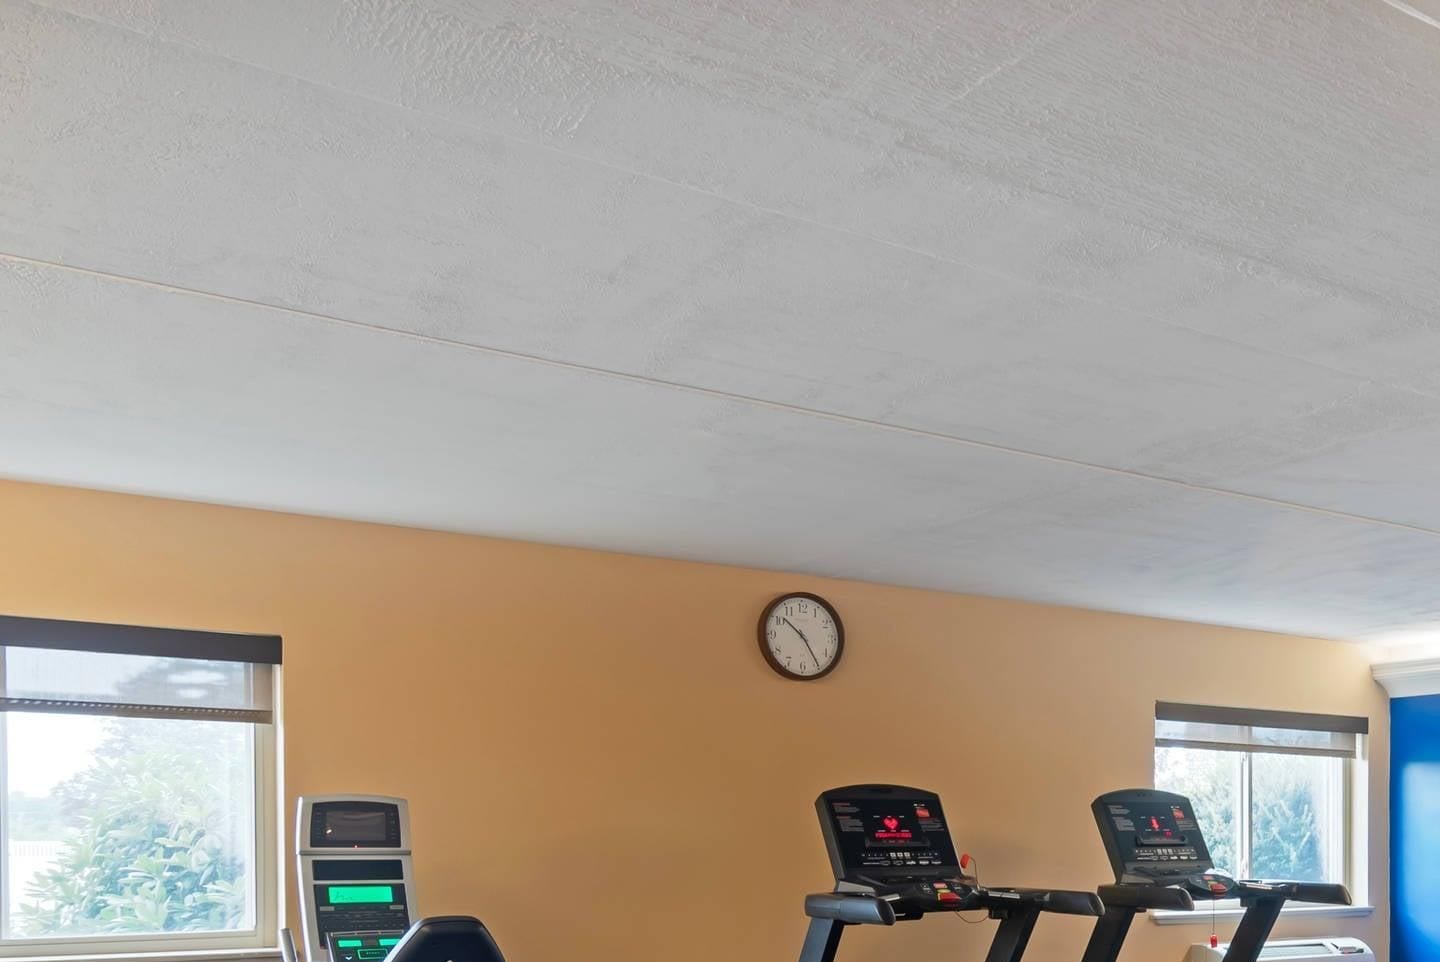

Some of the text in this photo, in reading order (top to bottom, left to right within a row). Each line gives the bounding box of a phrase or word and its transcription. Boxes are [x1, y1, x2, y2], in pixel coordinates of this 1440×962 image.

[785, 606, 793, 617] 11
[798, 602, 808, 614] 12
[770, 630, 777, 640] 9
[799, 660, 807, 672] 6
